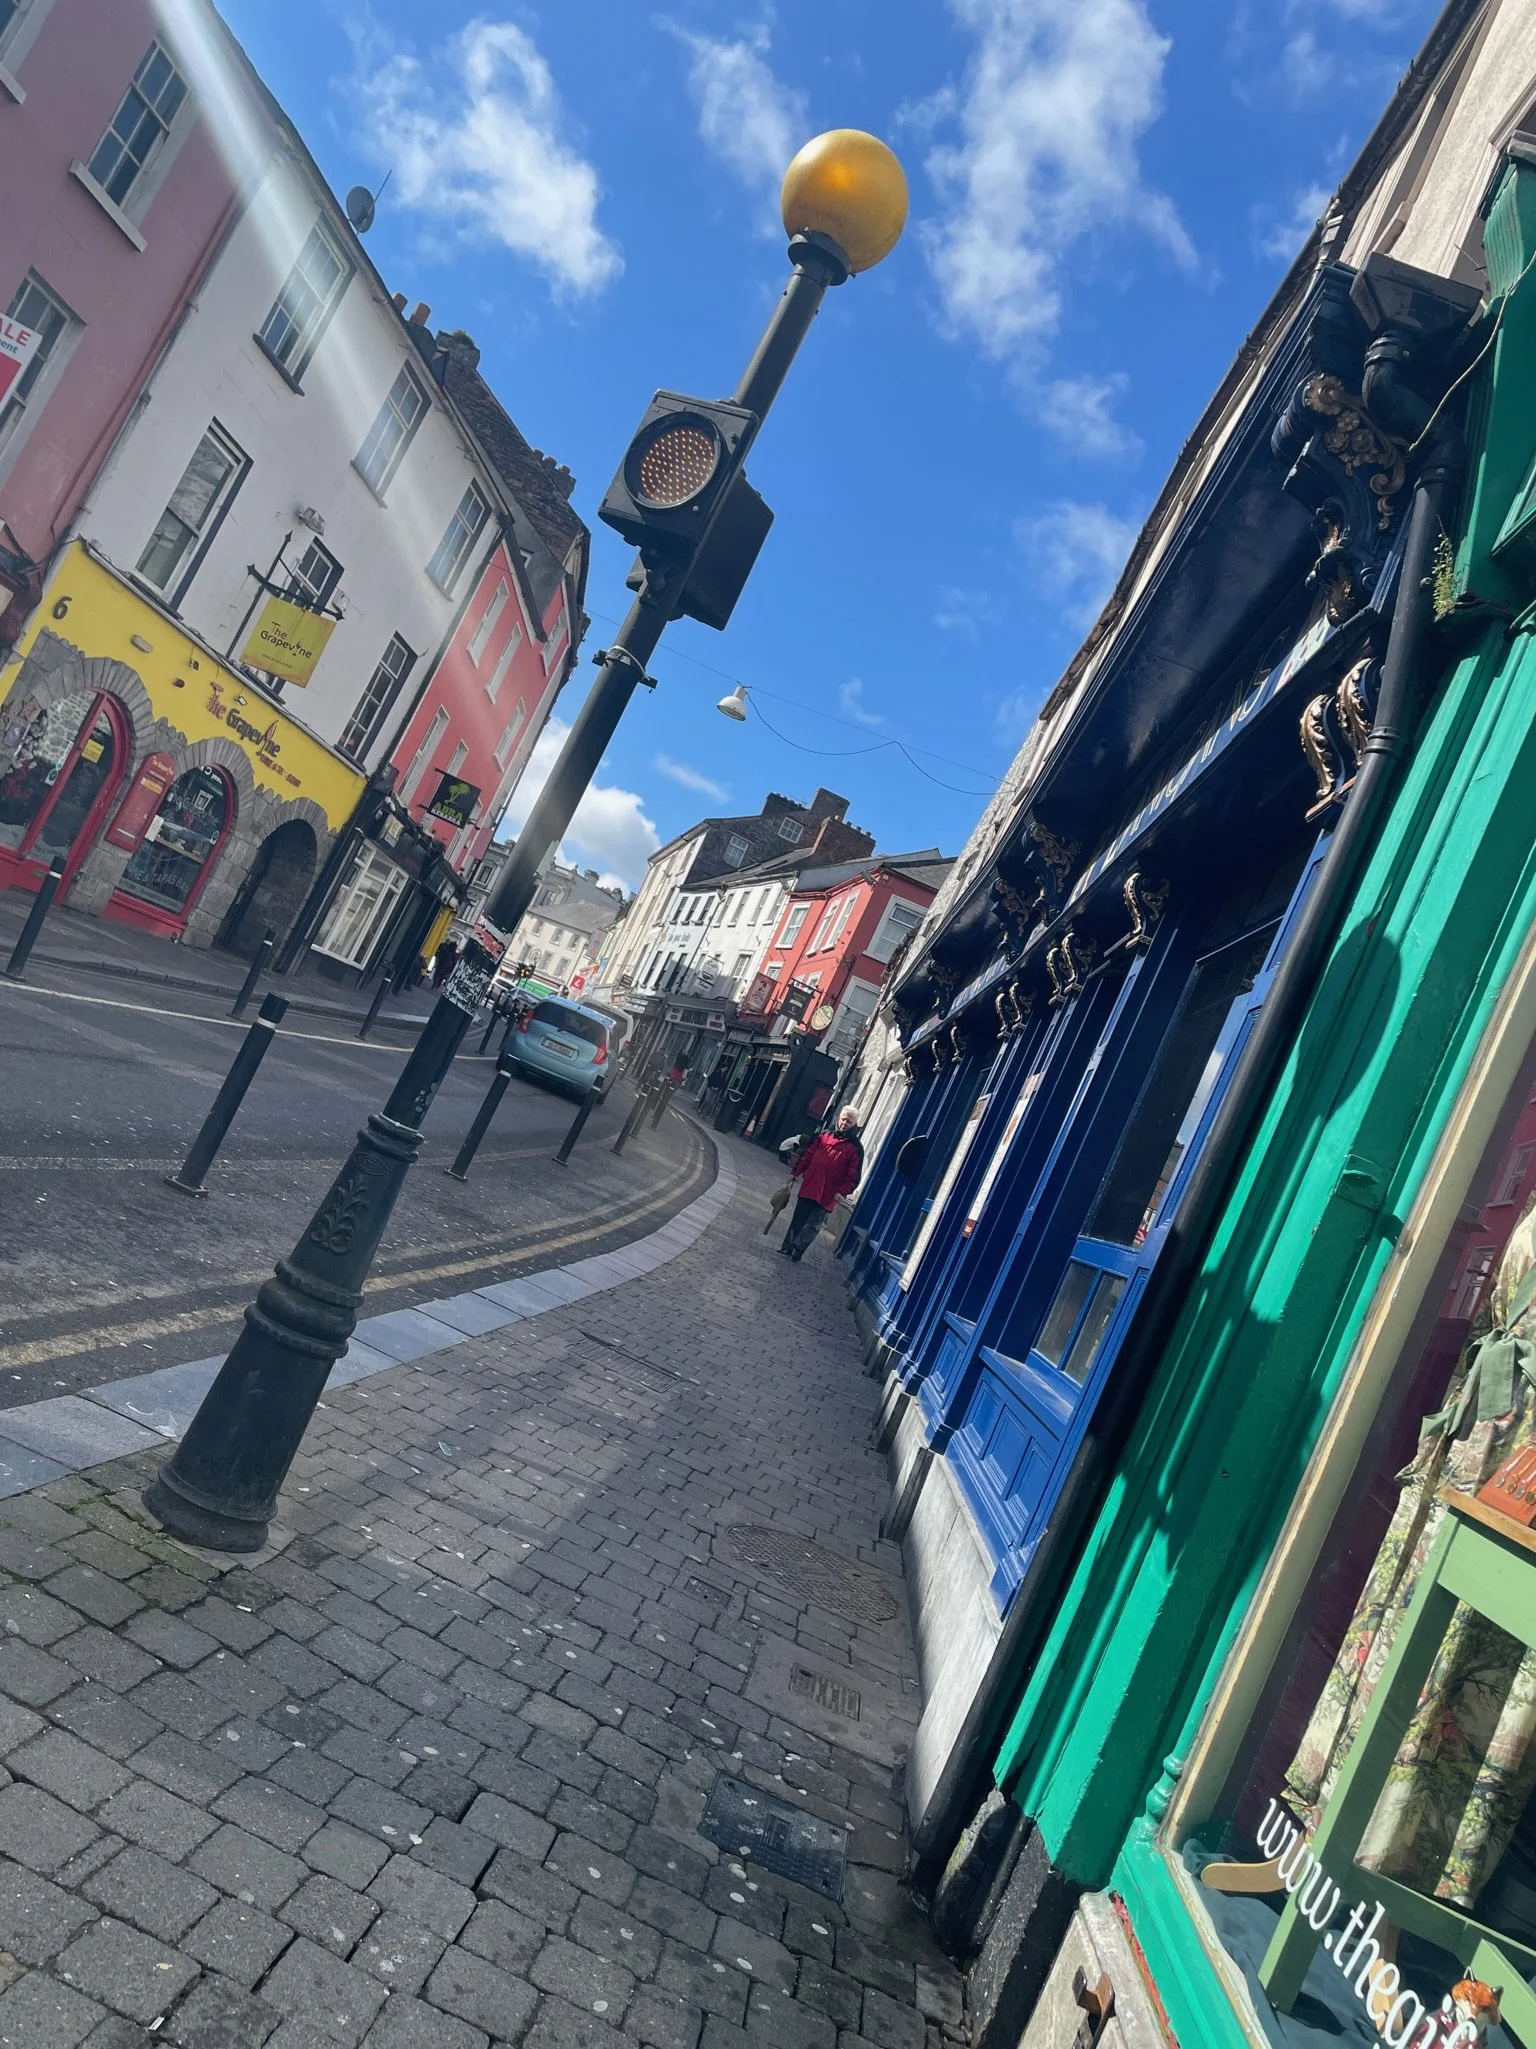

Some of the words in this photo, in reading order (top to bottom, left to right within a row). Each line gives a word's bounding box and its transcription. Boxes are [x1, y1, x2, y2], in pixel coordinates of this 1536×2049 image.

[53, 596, 72, 620] 6
[271, 621, 288, 640] The
[260, 630, 317, 659] Grapevine
[206, 682, 227, 720] The
[226, 708, 280, 758] Grapevine
[432, 802, 463, 822] ABRA
